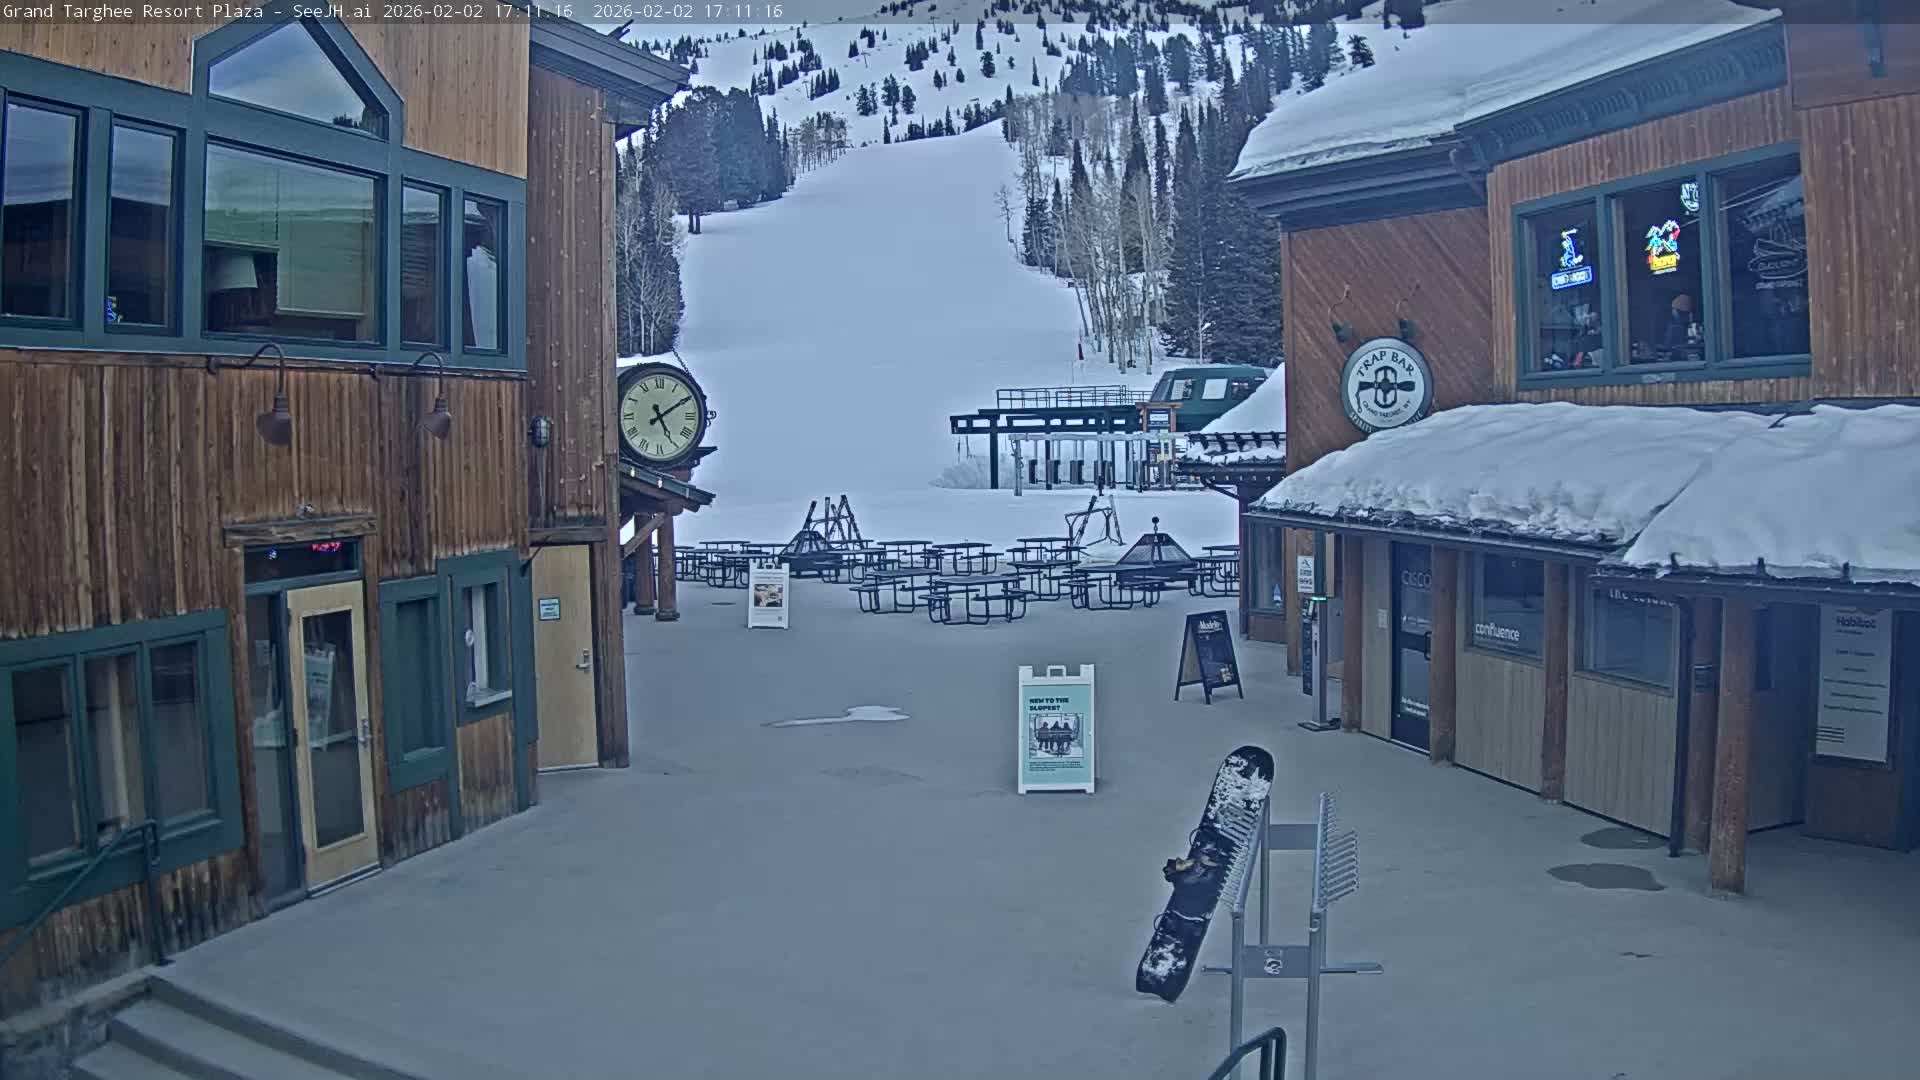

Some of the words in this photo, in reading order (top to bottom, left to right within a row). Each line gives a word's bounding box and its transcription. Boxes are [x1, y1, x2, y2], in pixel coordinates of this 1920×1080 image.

[1356, 350, 1387, 377] TRAP
[1391, 351, 1415, 376] BAR
[1475, 622, 1520, 642] confluence
